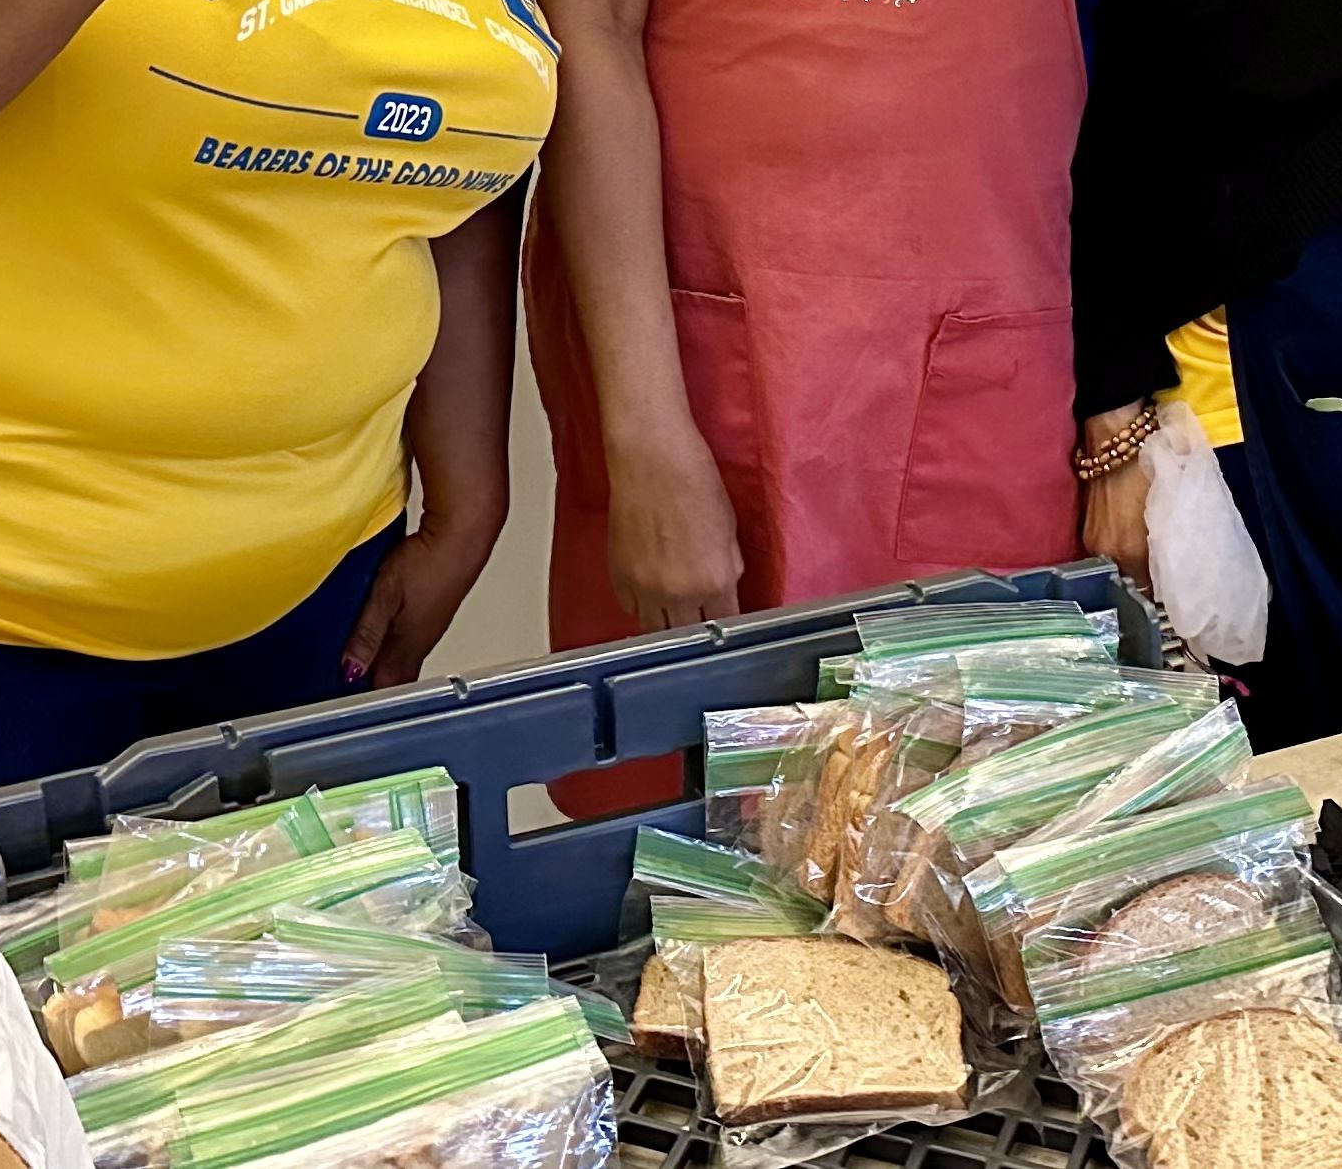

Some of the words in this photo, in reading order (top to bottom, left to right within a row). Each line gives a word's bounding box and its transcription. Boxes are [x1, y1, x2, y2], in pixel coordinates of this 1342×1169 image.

[376, 100, 433, 136] 2023
[193, 136, 314, 177] BEARERS
[313, 152, 349, 178] OF
[344, 157, 393, 184] THE
[391, 161, 461, 188] GOOD
[453, 171, 516, 195] NEWS
